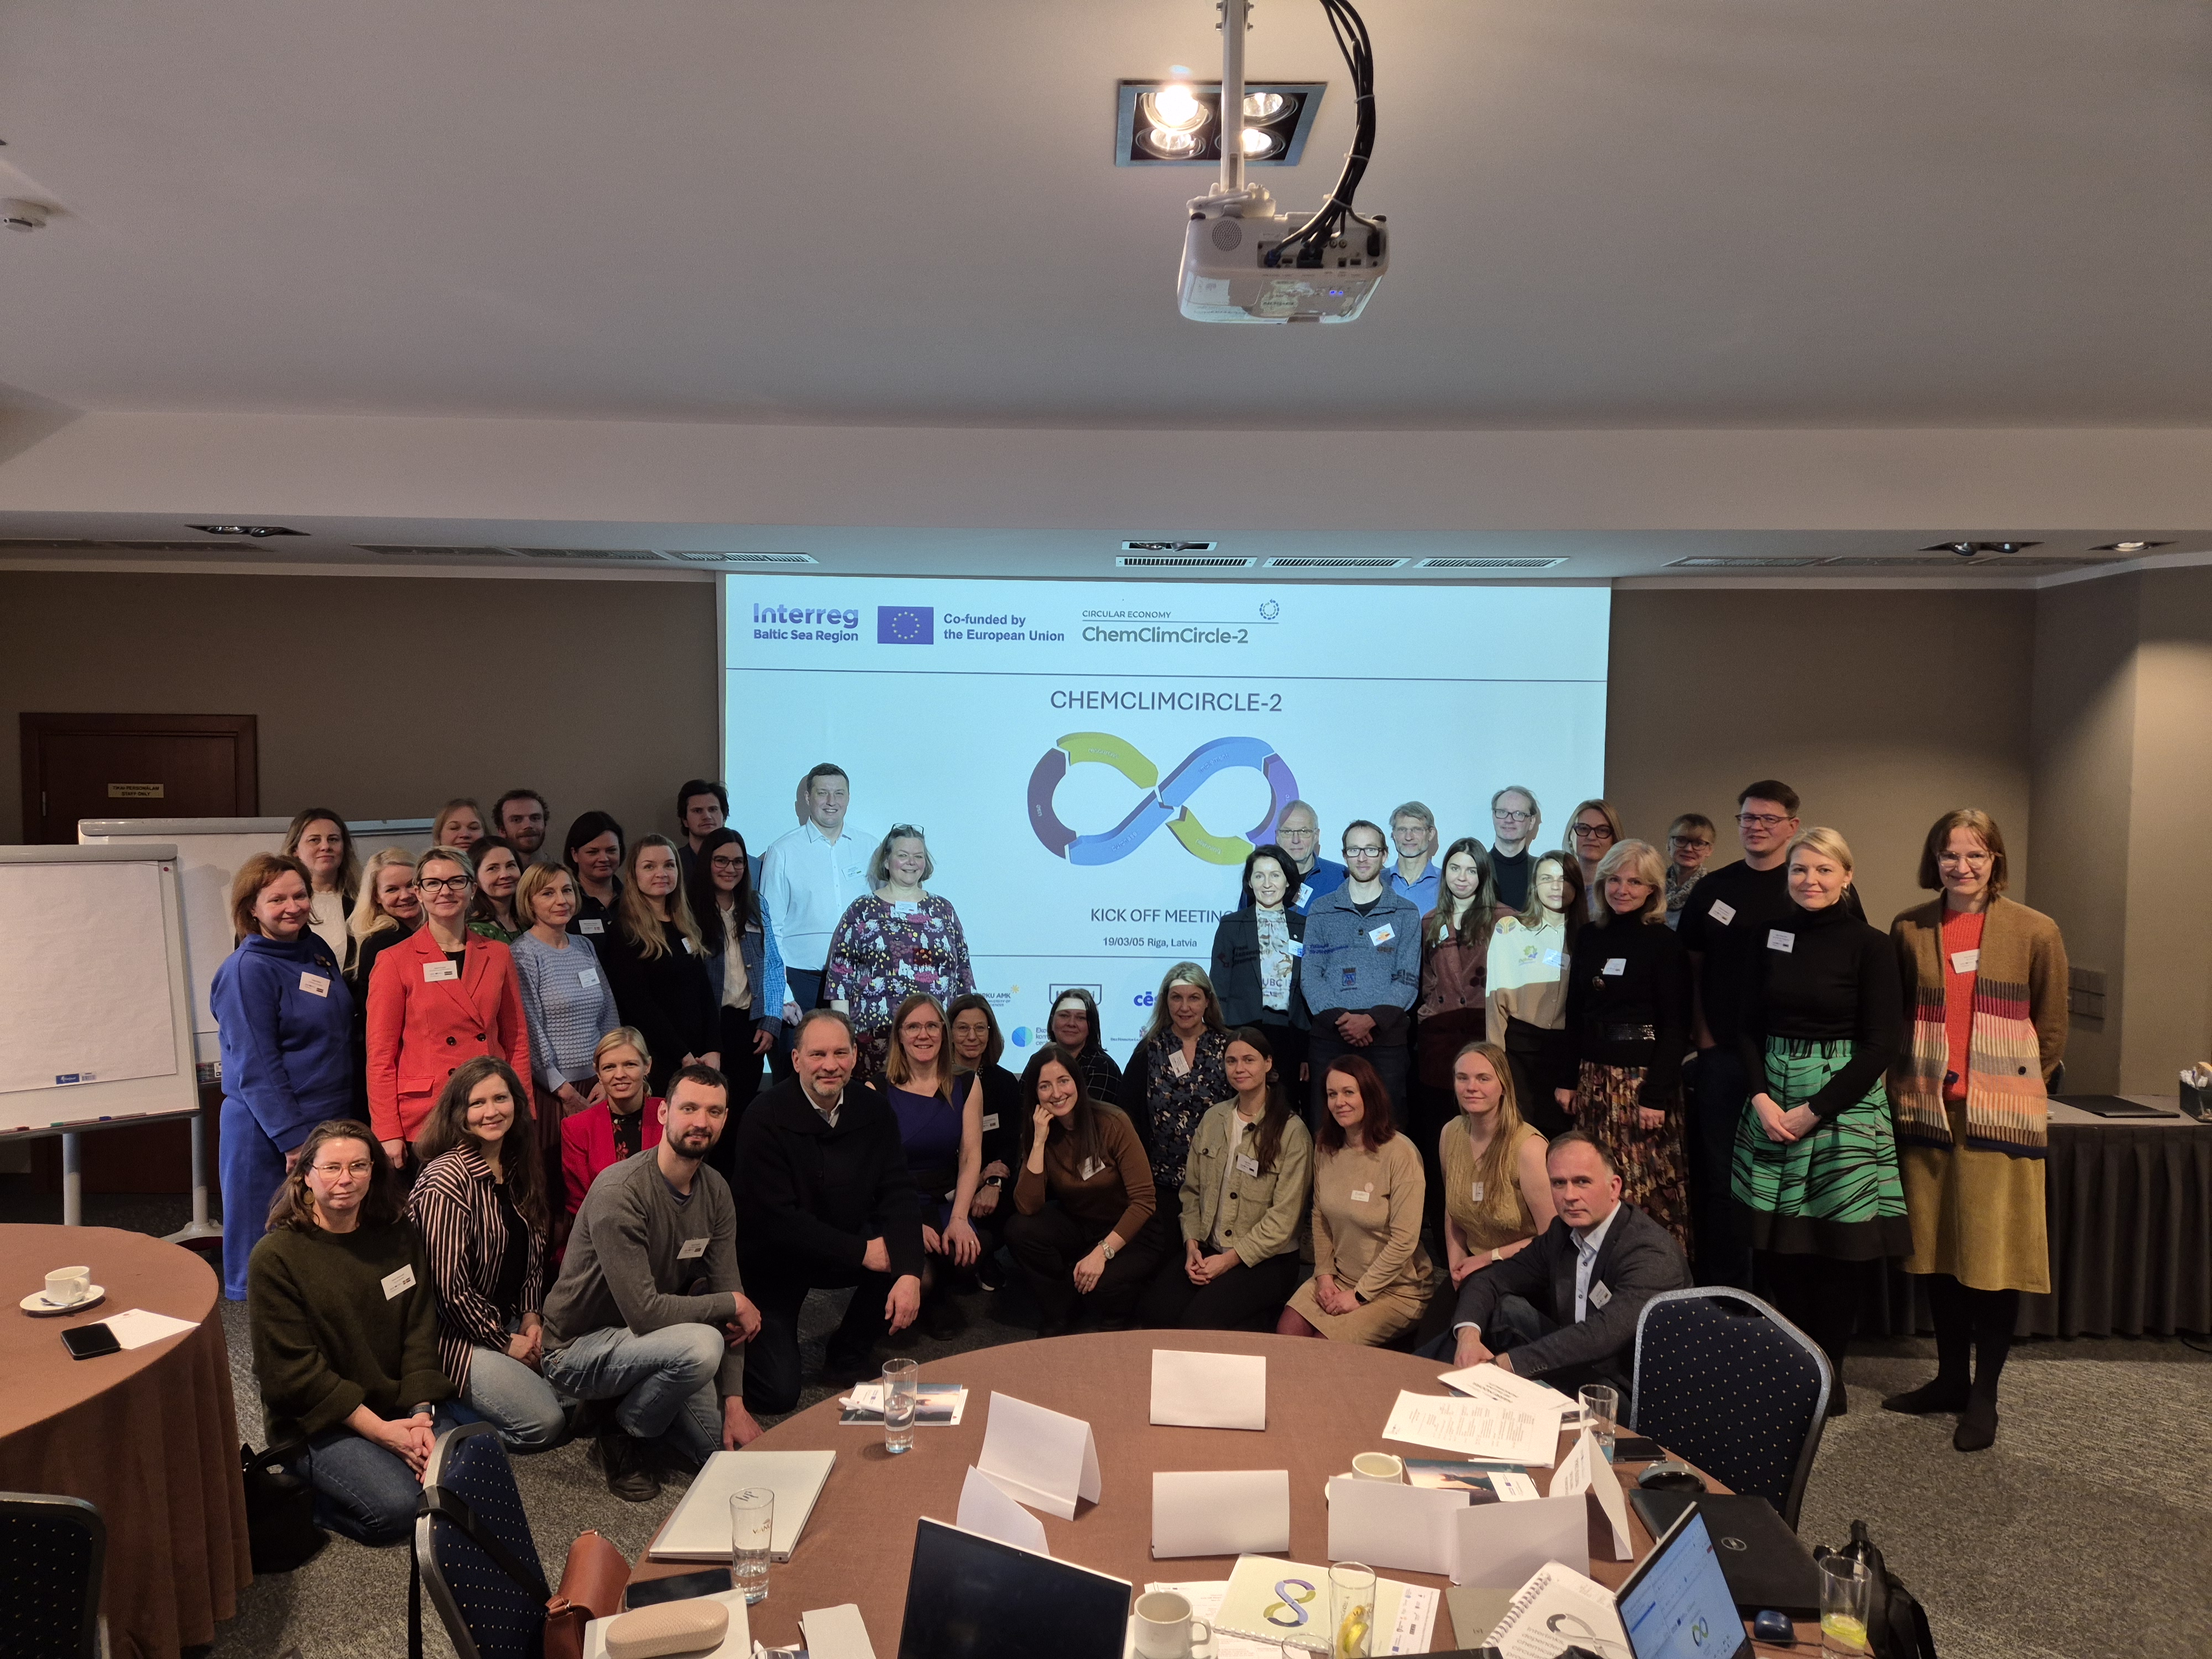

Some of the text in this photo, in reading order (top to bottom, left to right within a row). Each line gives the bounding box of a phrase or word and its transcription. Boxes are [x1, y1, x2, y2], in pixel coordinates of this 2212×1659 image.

[753, 603, 859, 628] Interreg
[943, 613, 1026, 627] Co-funded by
[1082, 609, 1171, 619] CIRCULAR ECONOMY
[753, 629, 859, 642] Baltic Sea Region
[943, 628, 1065, 643] the European Union
[1082, 626, 1249, 644] ChemClimCircle-2
[1050, 690, 1282, 712] CHEMCLIMCIRCLE-2
[1091, 909, 1234, 923] KICK OFF MEETIN
[1103, 937, 1197, 948] 19/03/05 Riga, Latvia
[1262, 978, 1282, 987] UBC
